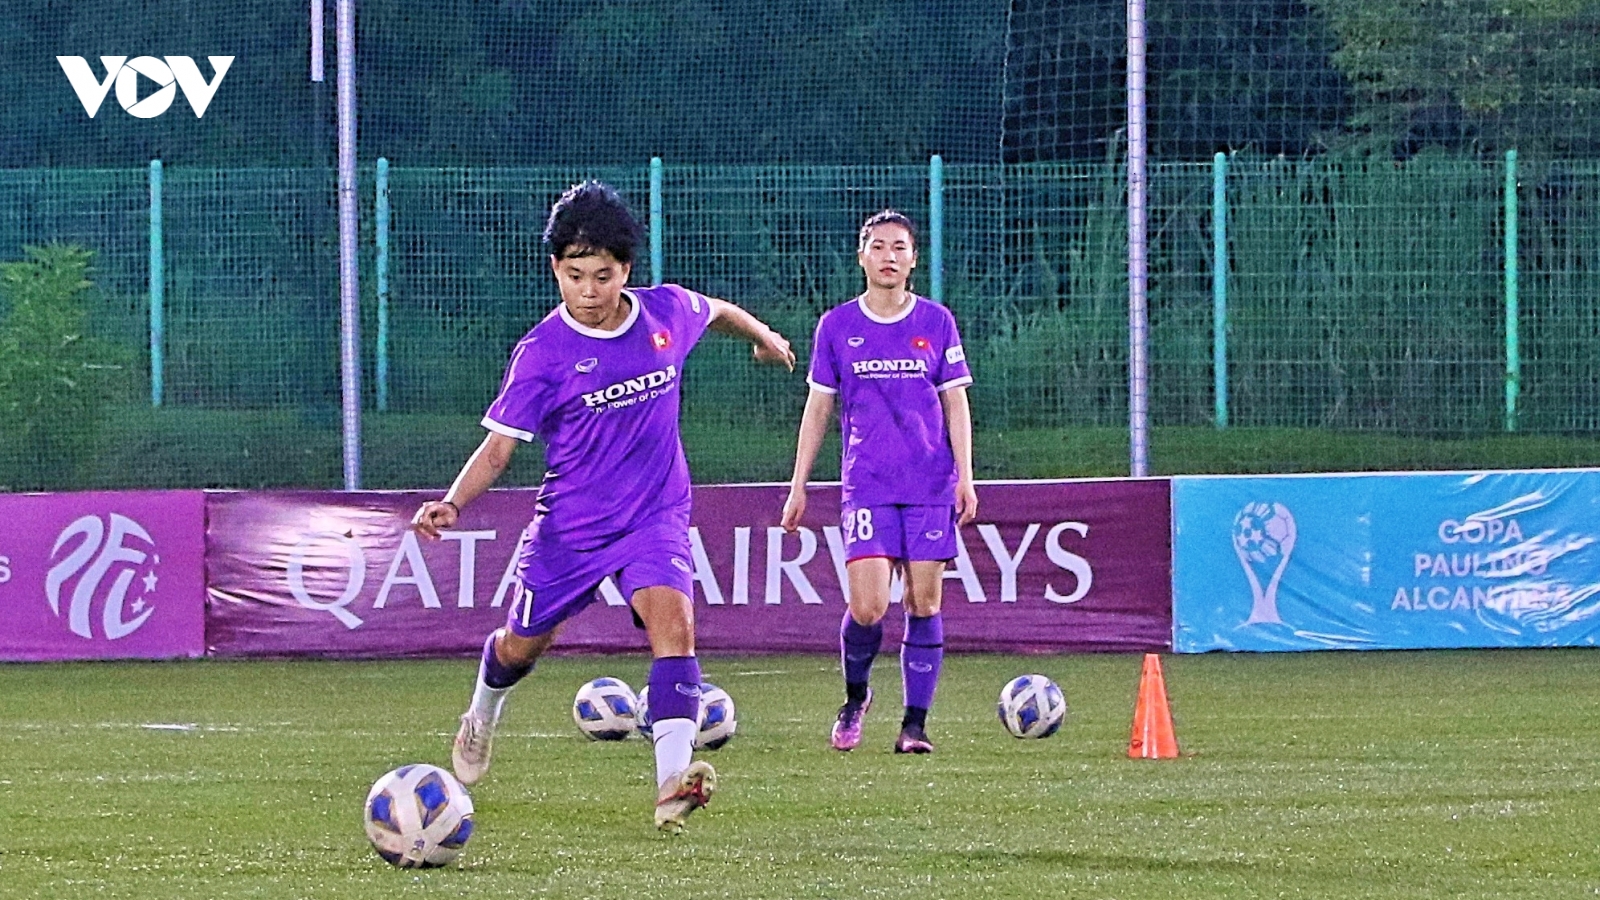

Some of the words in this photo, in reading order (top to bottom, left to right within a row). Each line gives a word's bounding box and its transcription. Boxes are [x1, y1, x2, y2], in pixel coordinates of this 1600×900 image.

[852, 359, 928, 373] HONDA
[581, 365, 676, 406] HONDA
[608, 397, 638, 409] Power
[638, 392, 650, 402] of
[842, 508, 873, 545] 28
[1438, 518, 1523, 544] COPA
[286, 529, 627, 630] QATA
